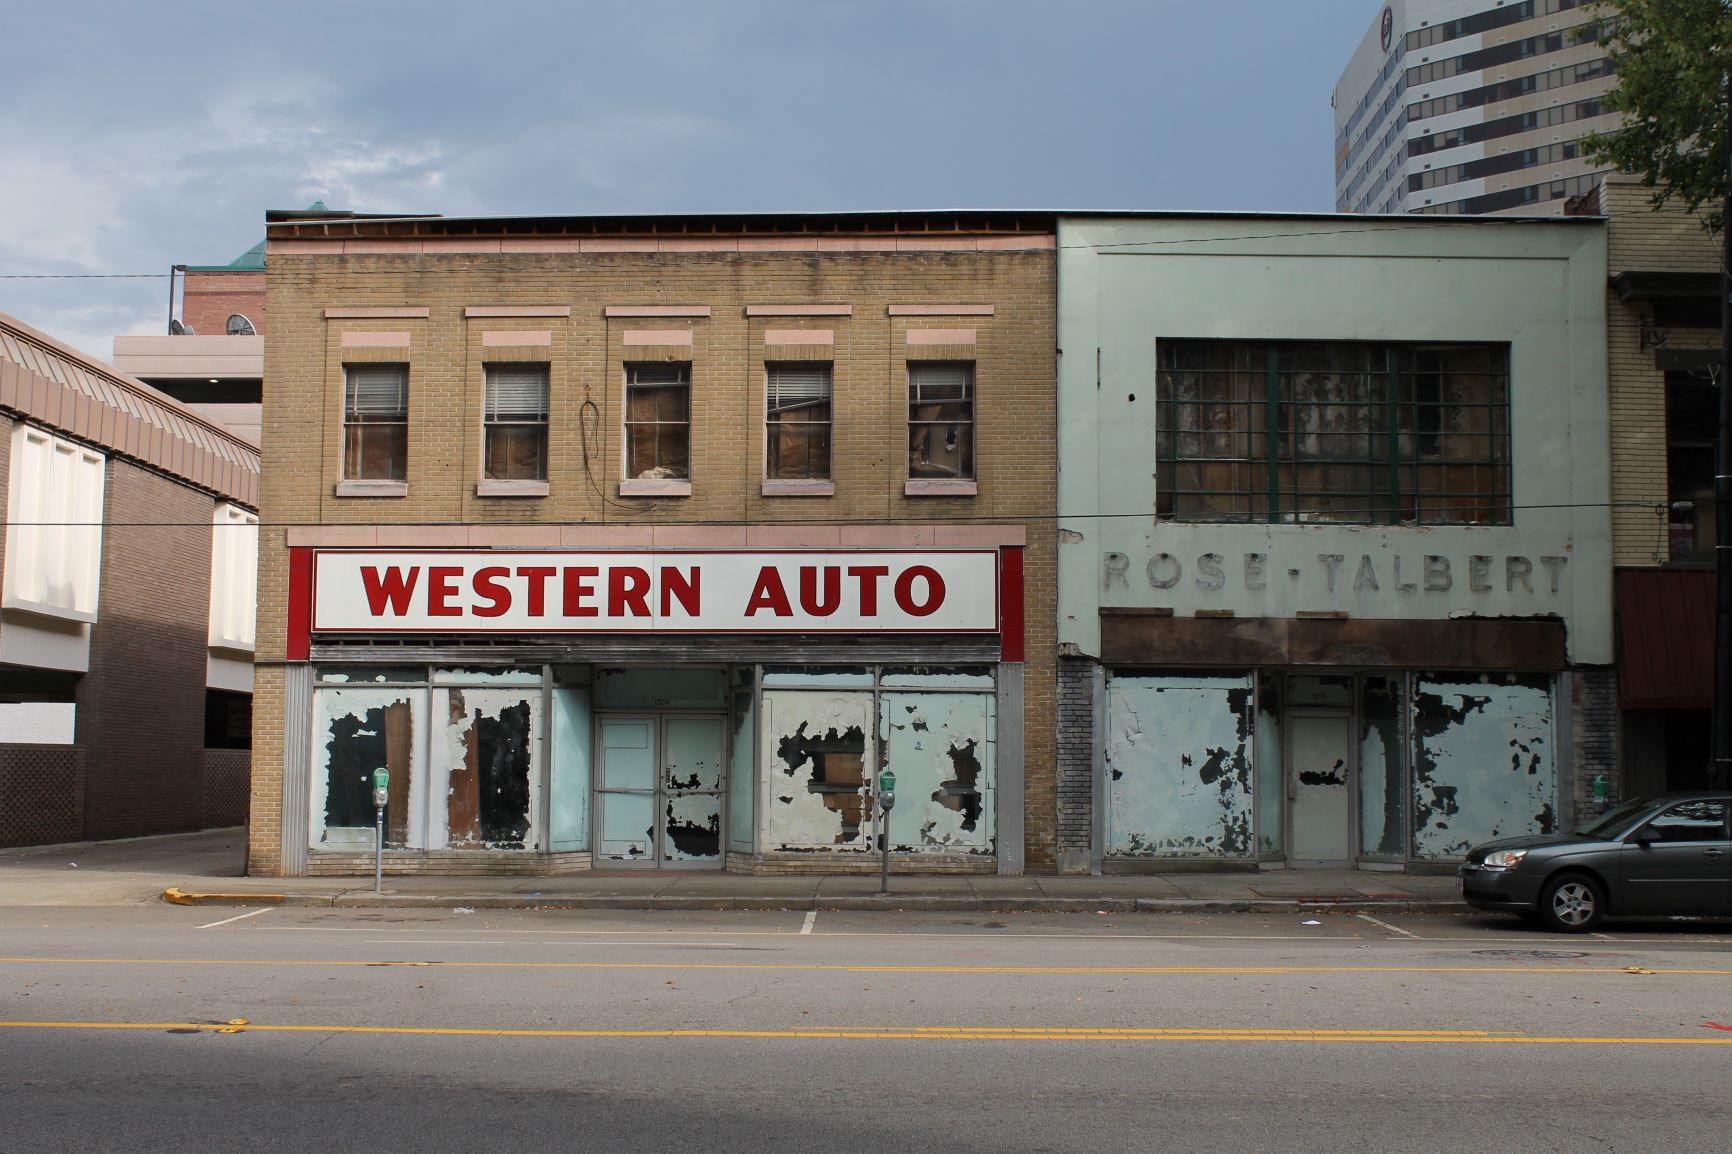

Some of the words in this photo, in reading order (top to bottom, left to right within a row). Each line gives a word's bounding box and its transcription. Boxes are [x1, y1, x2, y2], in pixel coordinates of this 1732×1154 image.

[361, 566, 701, 617] WESTERN
[746, 566, 945, 617] AUTO
[1103, 552, 1267, 592] ROSE
[1317, 553, 1568, 593] TALBERT
